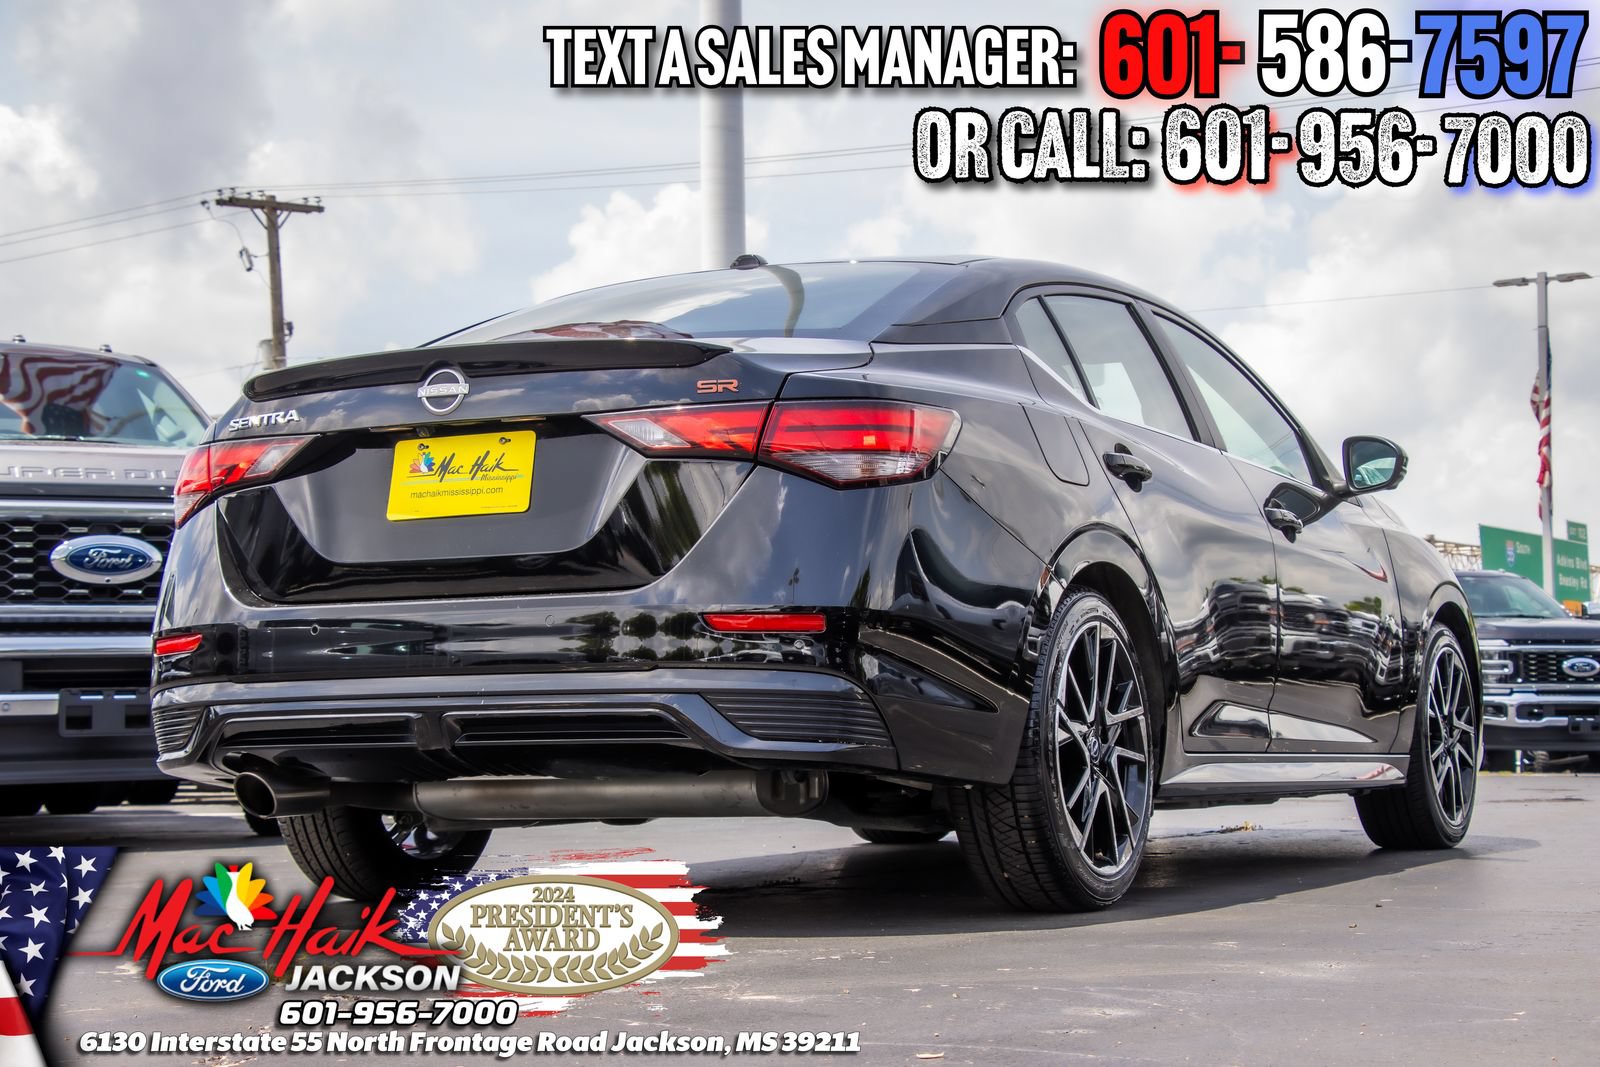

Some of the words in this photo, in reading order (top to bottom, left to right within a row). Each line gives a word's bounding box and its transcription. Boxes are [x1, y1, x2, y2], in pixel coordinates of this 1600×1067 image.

[418, 384, 469, 398] NISSAN
[697, 379, 739, 393] SR
[228, 409, 300, 432] SENTRA
[424, 453, 467, 482] Mac
[469, 450, 518, 480] Haik
[480, 474, 517, 483] Mississippi
[410, 486, 504, 499] machaikmississippi.com
[83, 548, 134, 568] Ford
